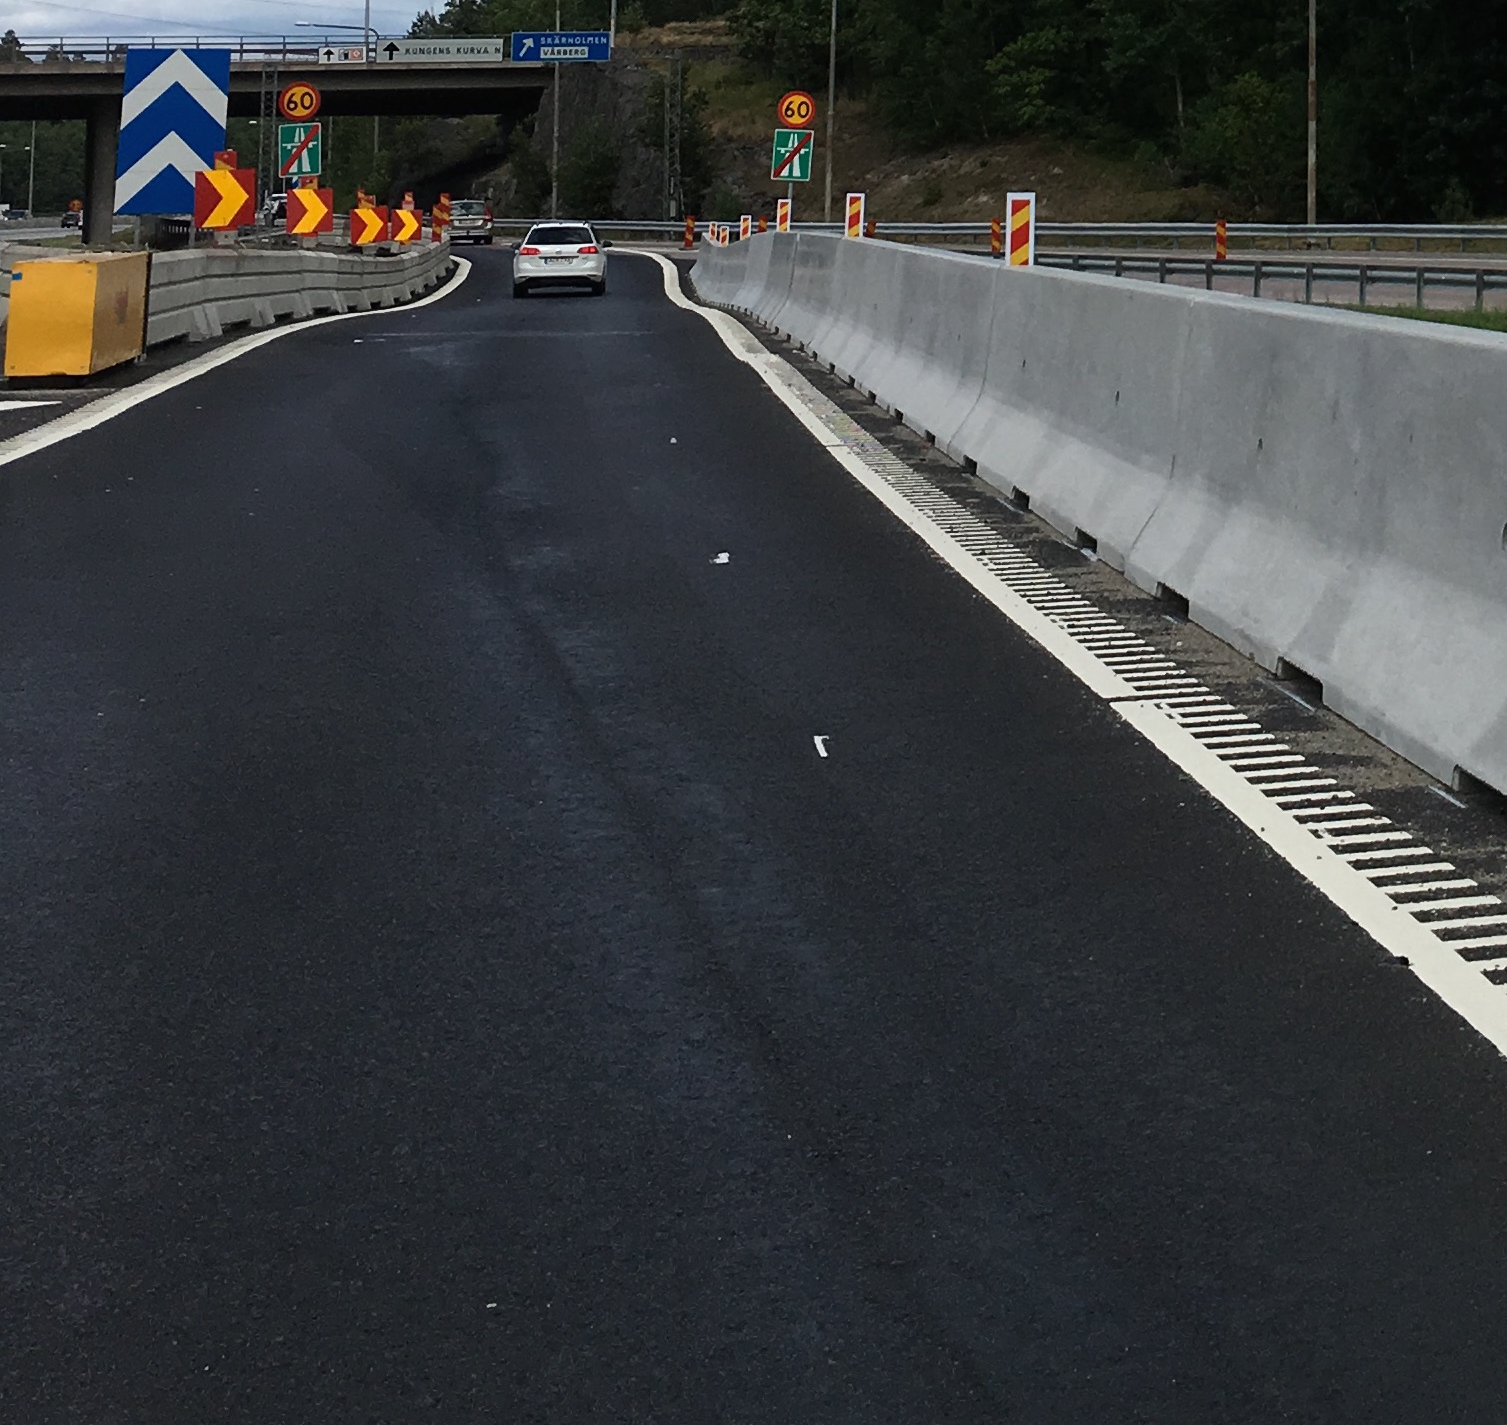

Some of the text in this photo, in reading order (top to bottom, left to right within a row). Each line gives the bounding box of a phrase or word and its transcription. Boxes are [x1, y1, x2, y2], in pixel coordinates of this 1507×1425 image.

[540, 35, 607, 44] SKÄRHOLMEN
[404, 46, 451, 55] KUNGENS
[456, 46, 489, 54] KURVA
[542, 47, 587, 56] VÅRBERG
[286, 91, 314, 111] 60
[784, 100, 810, 119] 60
